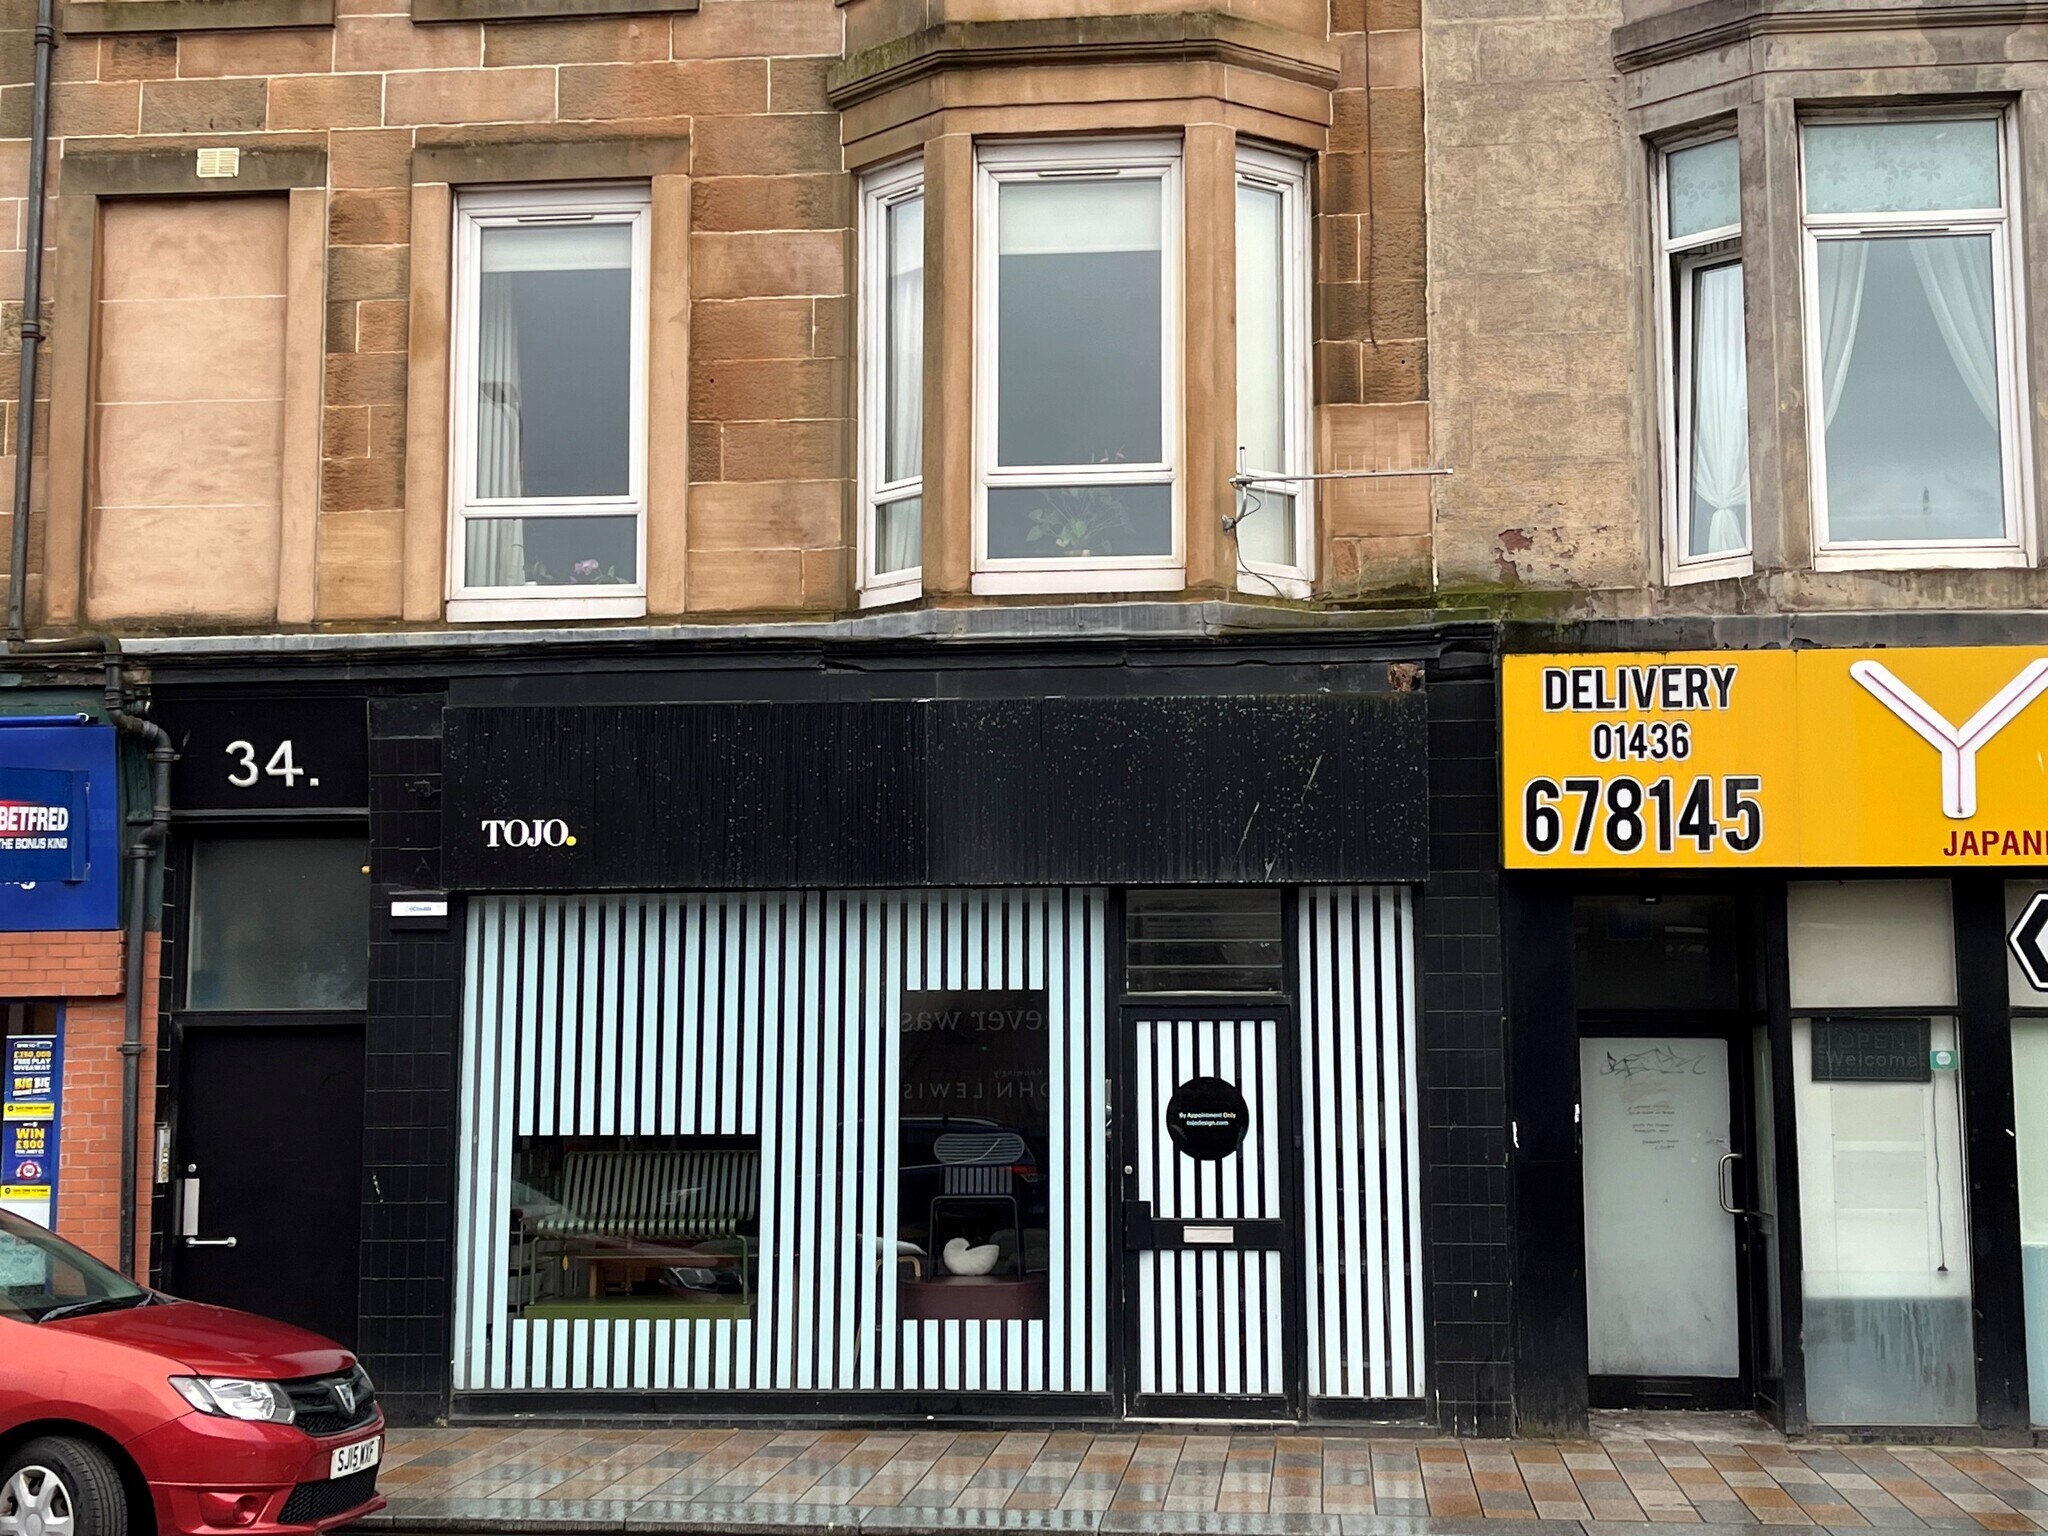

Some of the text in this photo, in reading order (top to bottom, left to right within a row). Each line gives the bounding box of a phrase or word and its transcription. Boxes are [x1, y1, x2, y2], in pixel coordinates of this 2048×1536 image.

[1544, 665, 1738, 711] DELIVERY
[1593, 722, 1690, 760] 01436
[225, 740, 319, 787] 34.
[0, 806, 69, 831] BETFRED
[1523, 776, 1762, 854] 678145
[15, 838, 46, 849] BONUS
[47, 838, 68, 849] KING
[1943, 830, 2048, 856] JAPAN
[1839, 1032, 1904, 1049] OPEN
[1826, 1050, 1917, 1066] Welcome
[16, 1128, 45, 1139] WIN
[16, 1140, 44, 1149] £800
